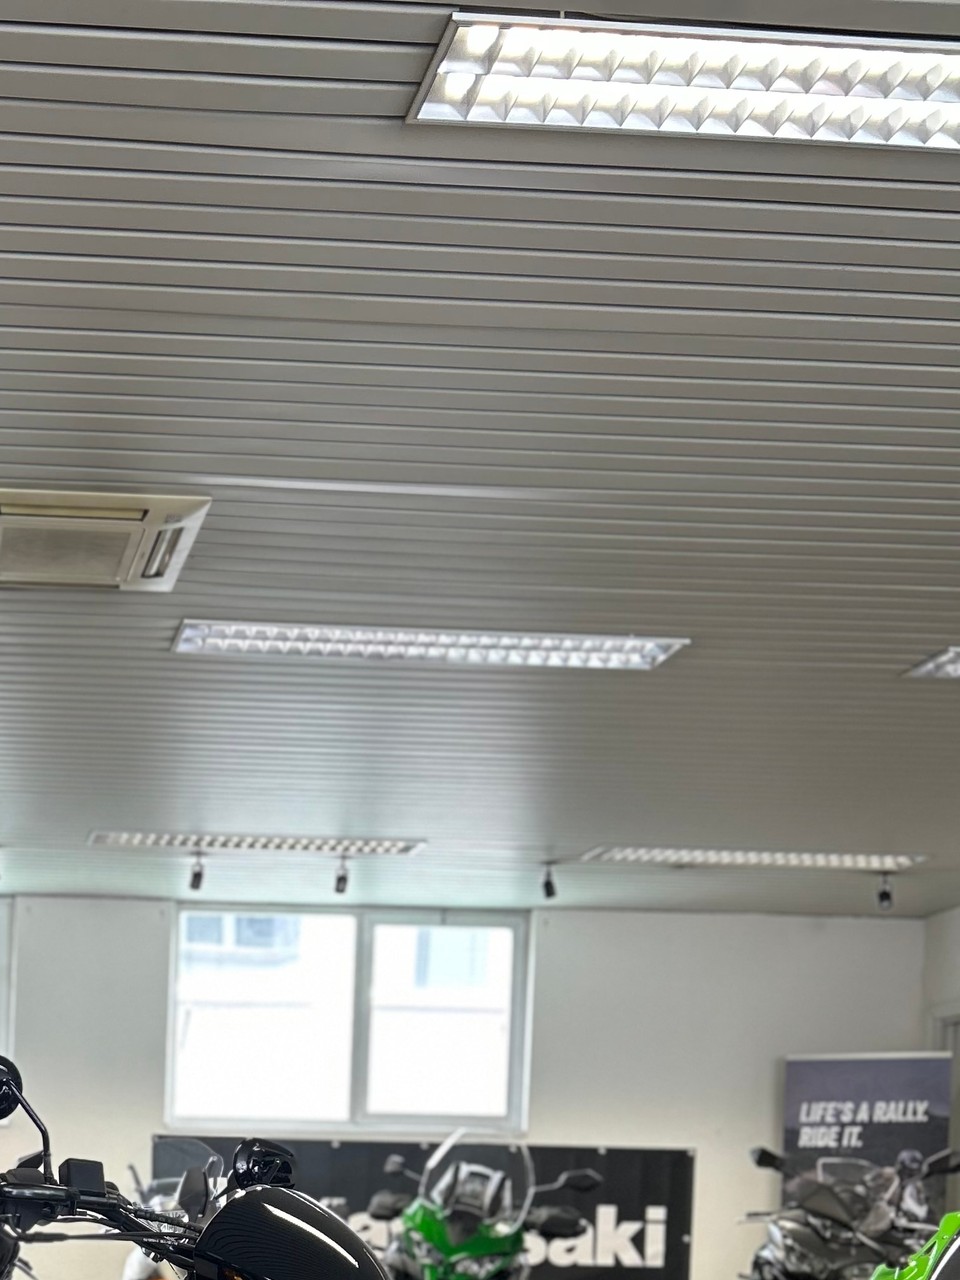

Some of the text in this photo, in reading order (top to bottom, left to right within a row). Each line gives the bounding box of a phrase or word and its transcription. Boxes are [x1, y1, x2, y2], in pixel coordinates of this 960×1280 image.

[799, 1101, 929, 1123] LIFE'S A RALLY.
[798, 1126, 863, 1148] RIDE IT.
